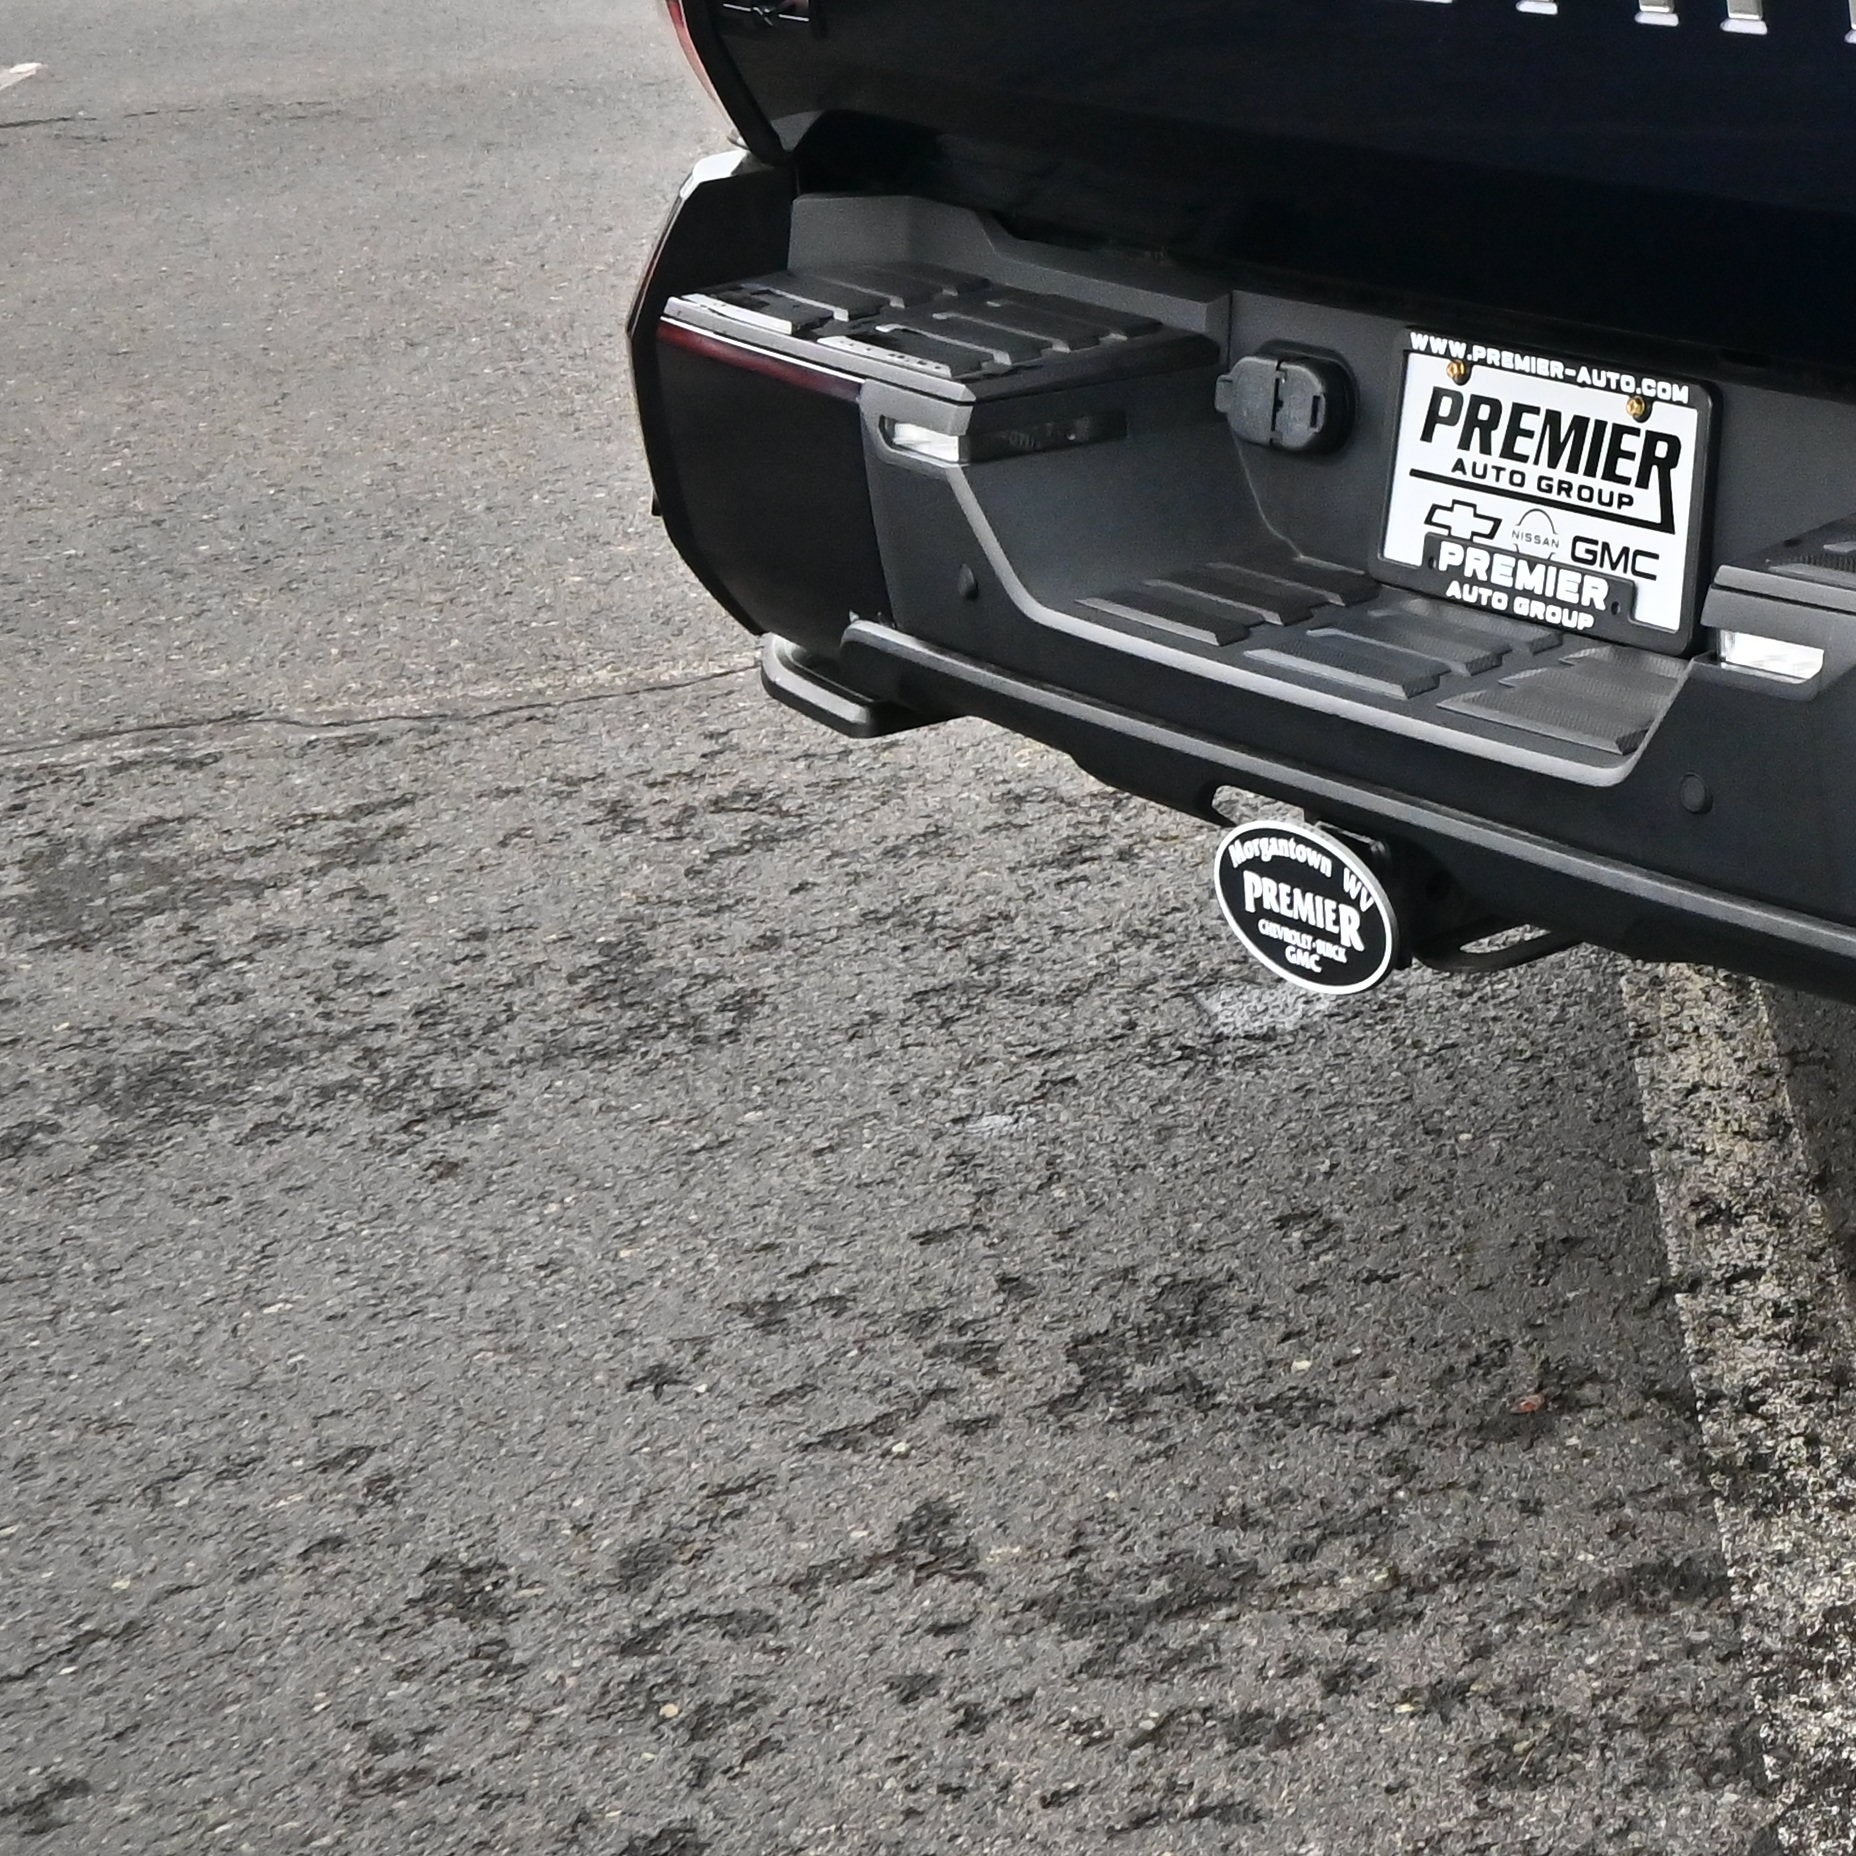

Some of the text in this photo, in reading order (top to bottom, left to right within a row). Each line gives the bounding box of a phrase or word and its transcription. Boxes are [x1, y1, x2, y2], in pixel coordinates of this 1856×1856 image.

[1409, 332, 1689, 404] WWW.PREMIER-AUTO.COM
[1420, 386, 1682, 494] PREMIER
[1451, 457, 1634, 510] AUTO GROUP
[1511, 528, 1560, 549] NISSAN
[1570, 534, 1660, 582] GMC
[1439, 541, 1610, 611] PREMIER
[1446, 581, 1594, 631] AUTO GROUP
[1228, 837, 1375, 912] Morgantown WV
[1243, 870, 1365, 952] PREMIER
[1285, 945, 1322, 973] GMC
